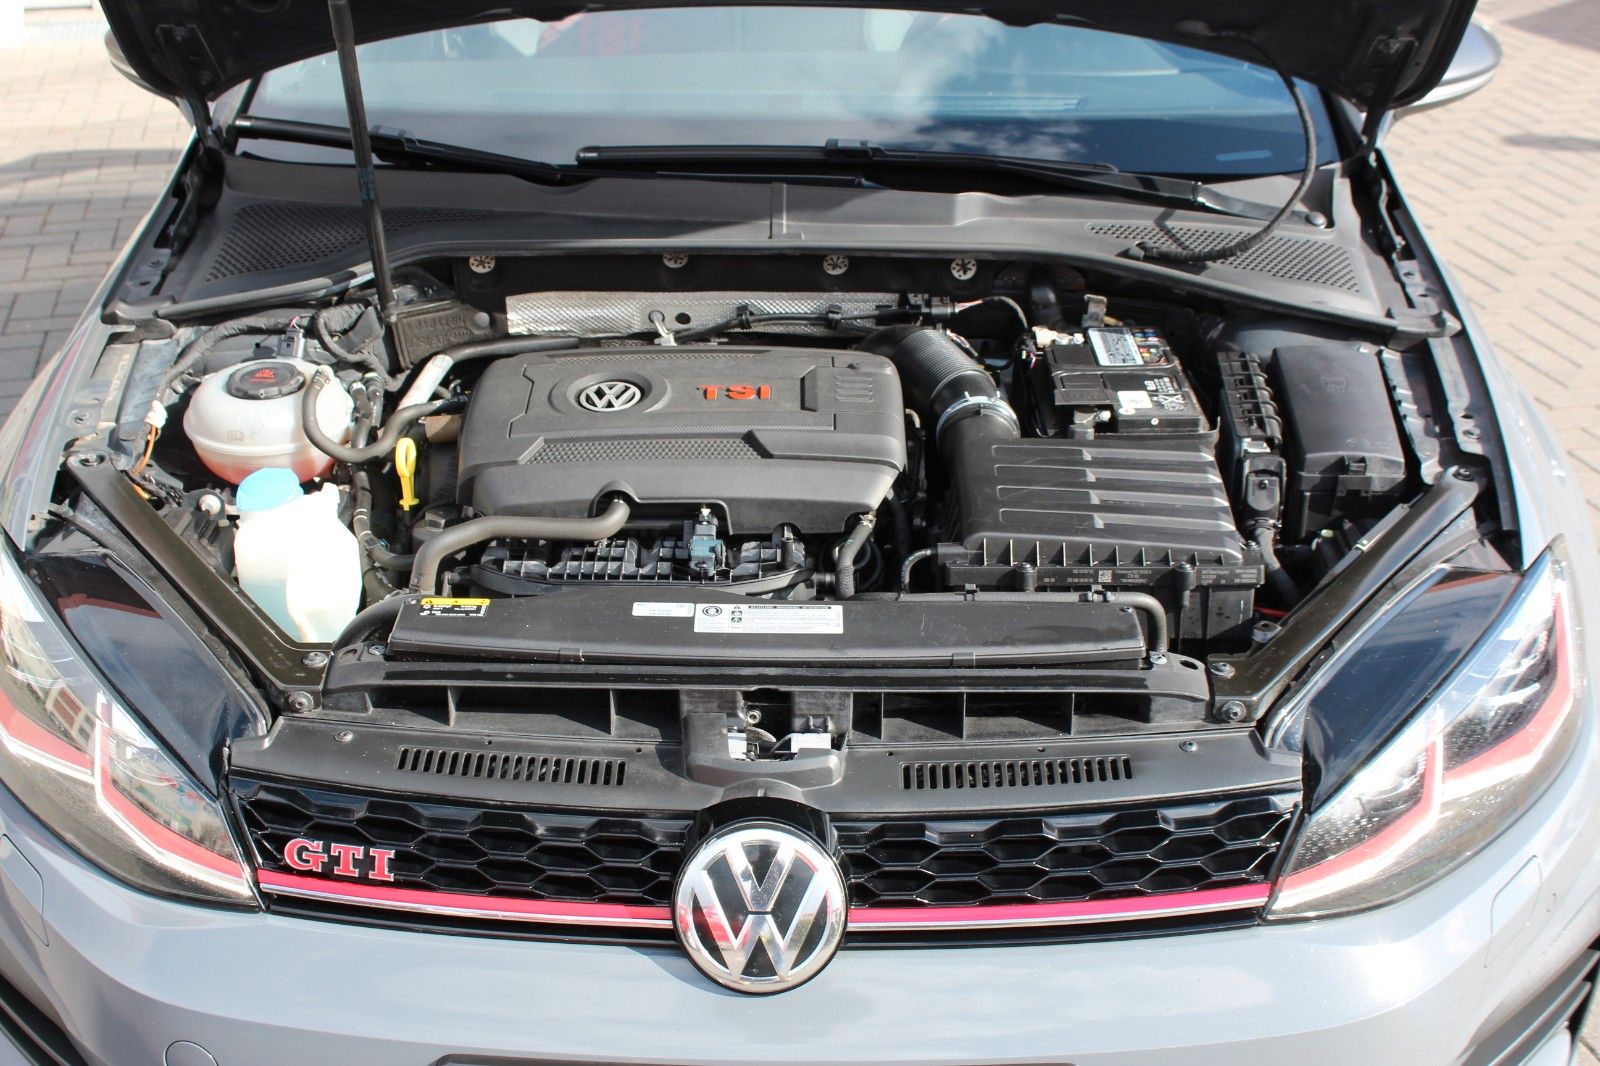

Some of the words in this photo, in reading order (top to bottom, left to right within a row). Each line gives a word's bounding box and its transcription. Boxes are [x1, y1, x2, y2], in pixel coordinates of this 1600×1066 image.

[697, 384, 771, 400] TSI
[284, 838, 396, 882] GTI
[680, 827, 840, 985] VW
